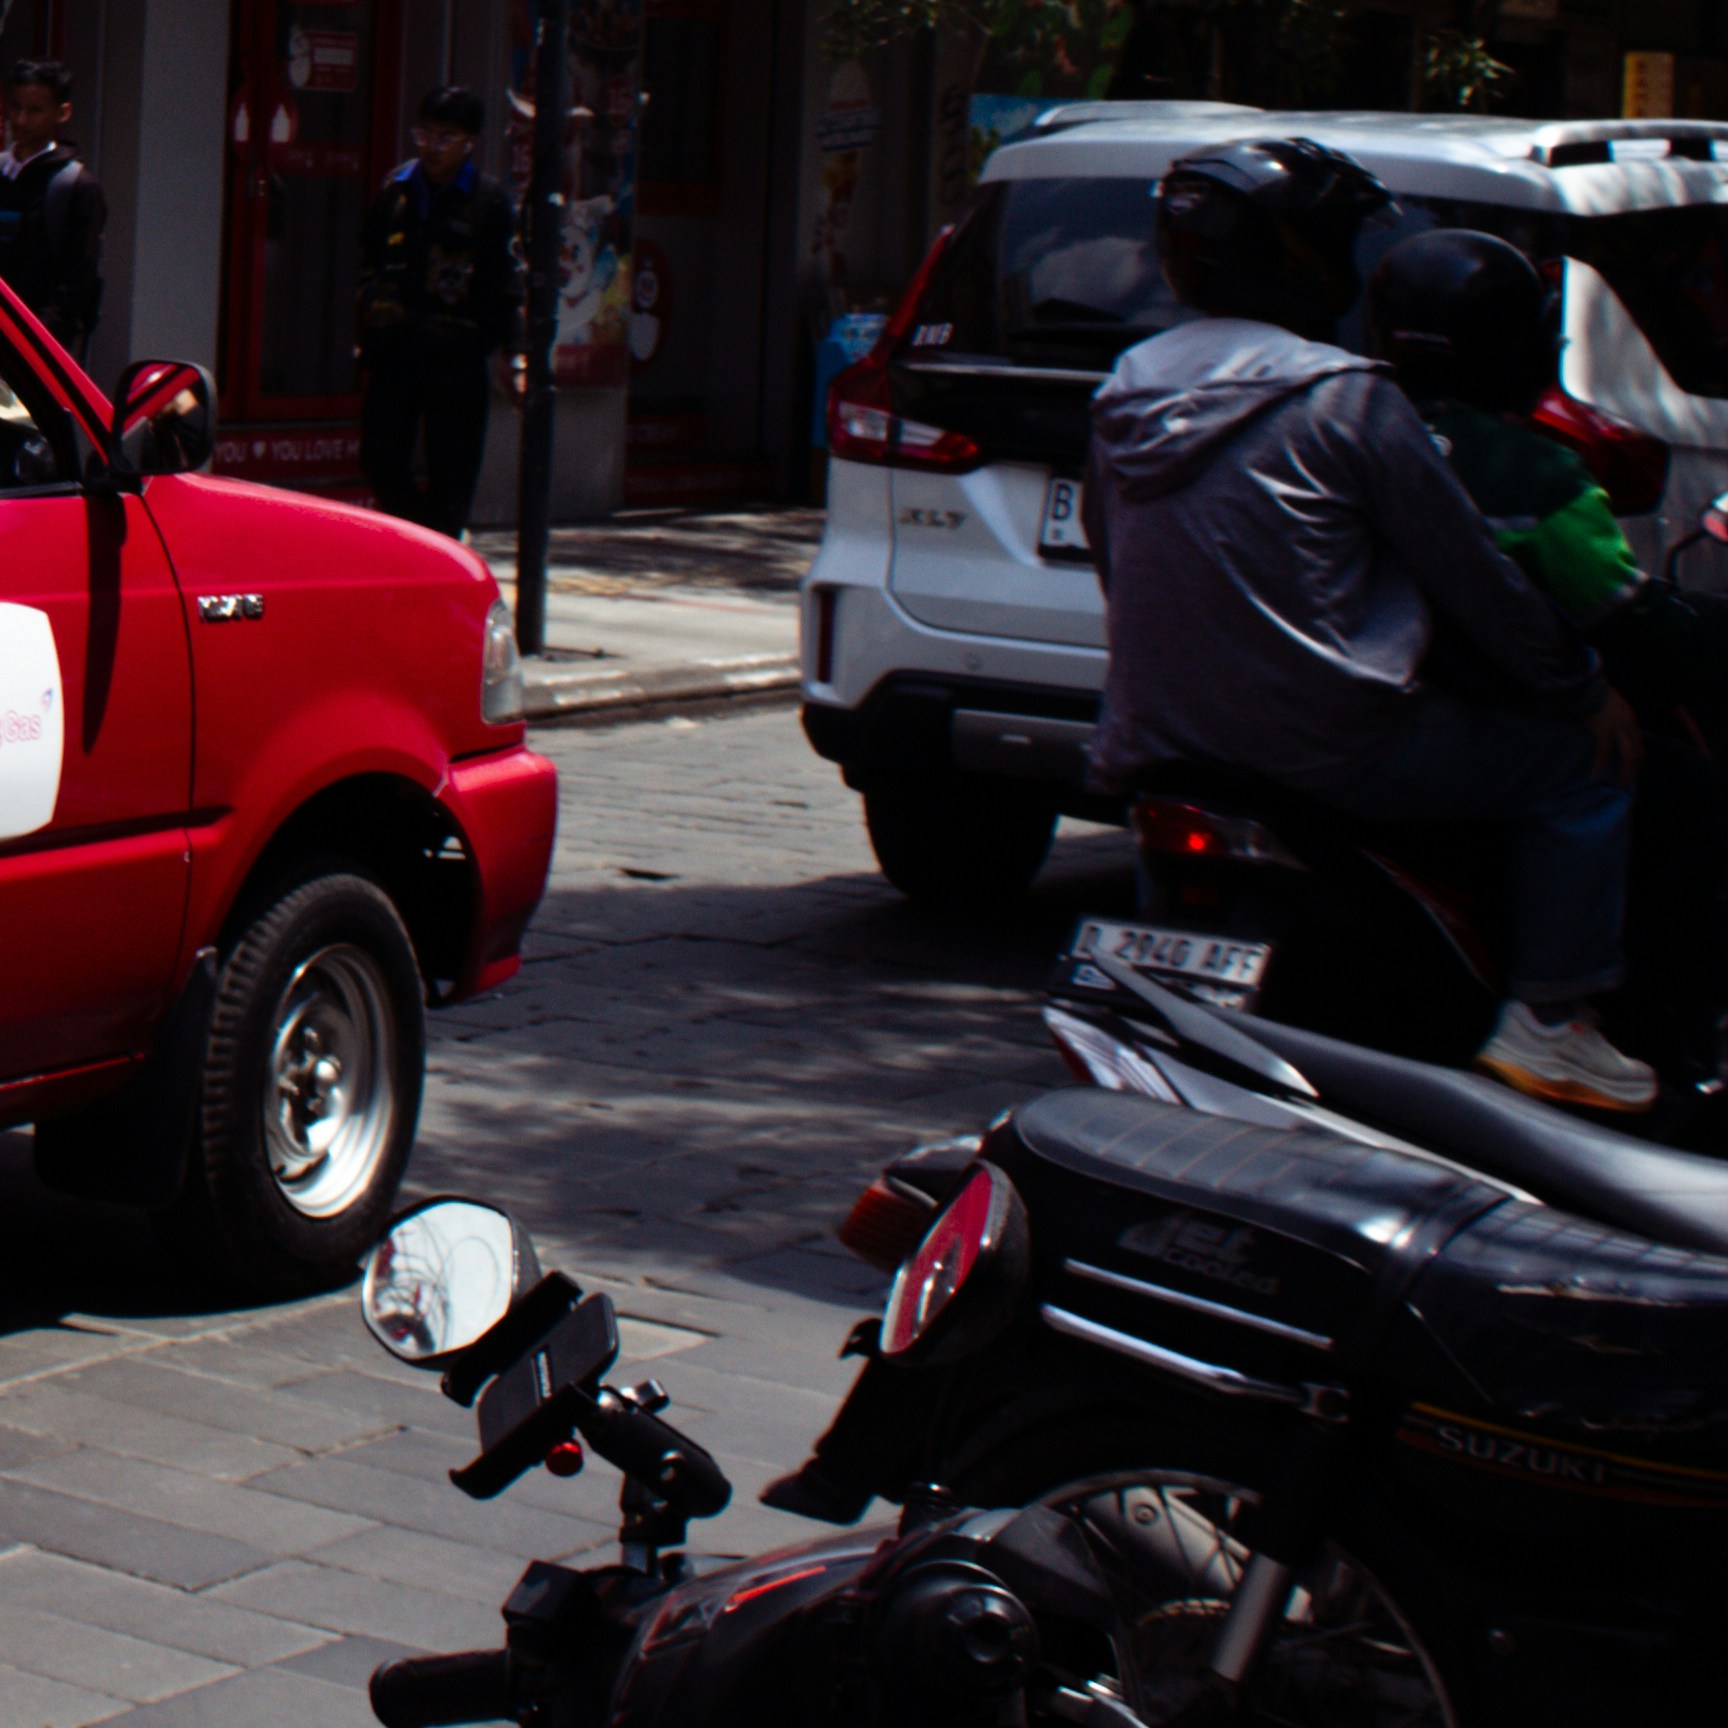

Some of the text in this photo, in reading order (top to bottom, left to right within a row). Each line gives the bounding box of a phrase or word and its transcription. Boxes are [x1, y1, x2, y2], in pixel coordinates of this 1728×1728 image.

[1052, 483, 1073, 522] B
[4, 712, 42, 744] Gas
[1436, 1424, 1608, 1486] SUZUKI
